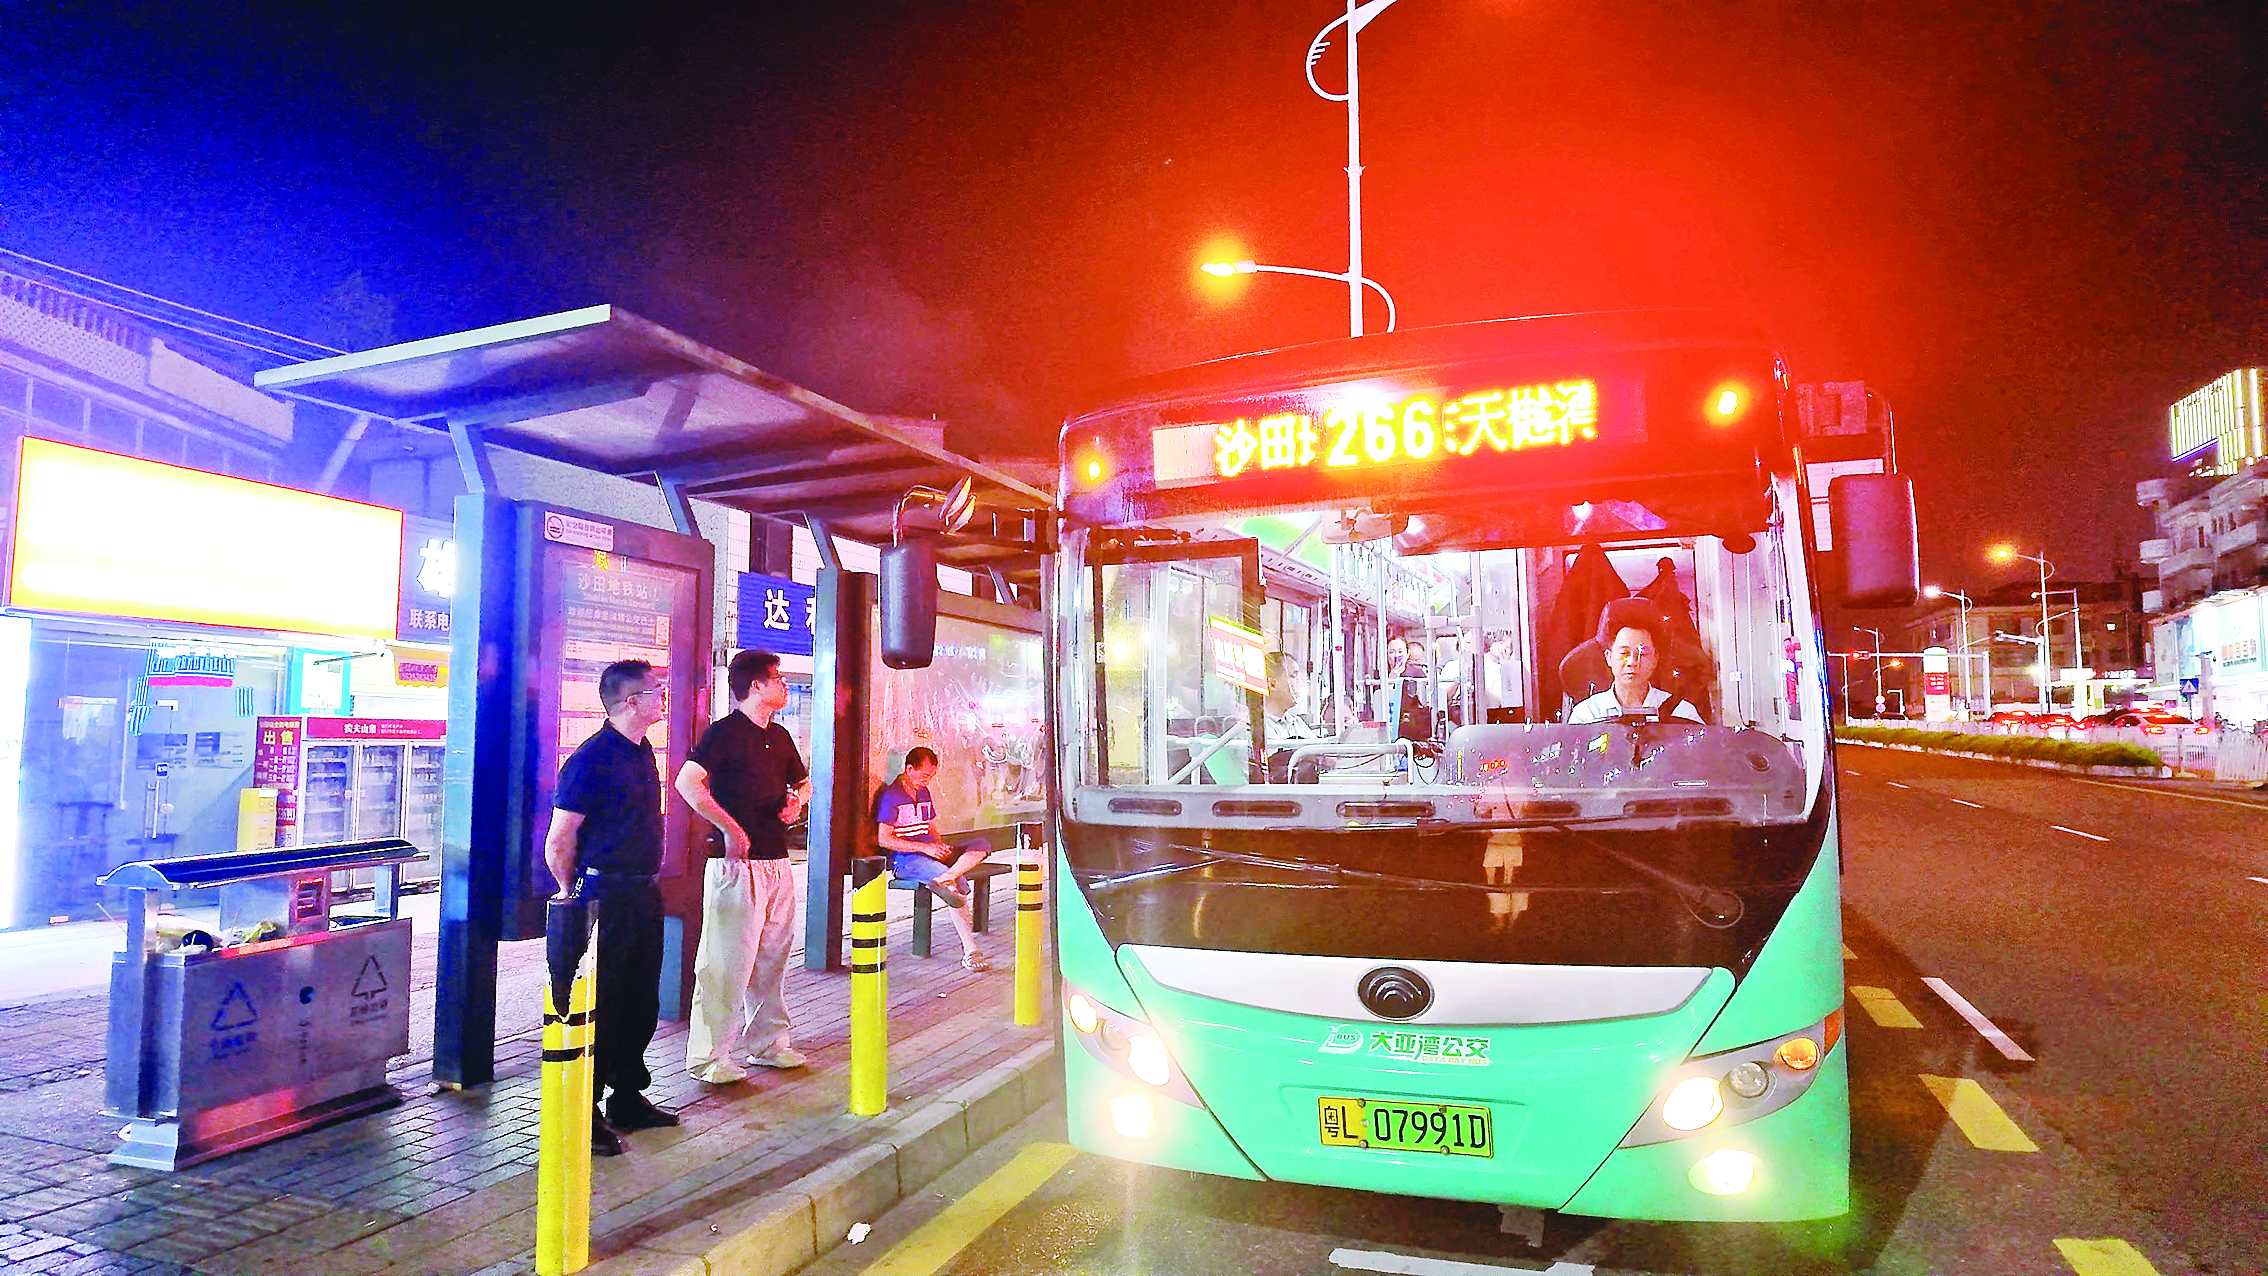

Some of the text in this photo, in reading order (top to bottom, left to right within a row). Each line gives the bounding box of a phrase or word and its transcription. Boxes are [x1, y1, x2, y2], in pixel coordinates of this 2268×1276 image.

[1326, 400, 1435, 466] 266
[1336, 1033, 1356, 1041] BUS
[1370, 1031, 1490, 1060] 大亚湾公交
[1373, 1108, 1486, 1149] 07991D
